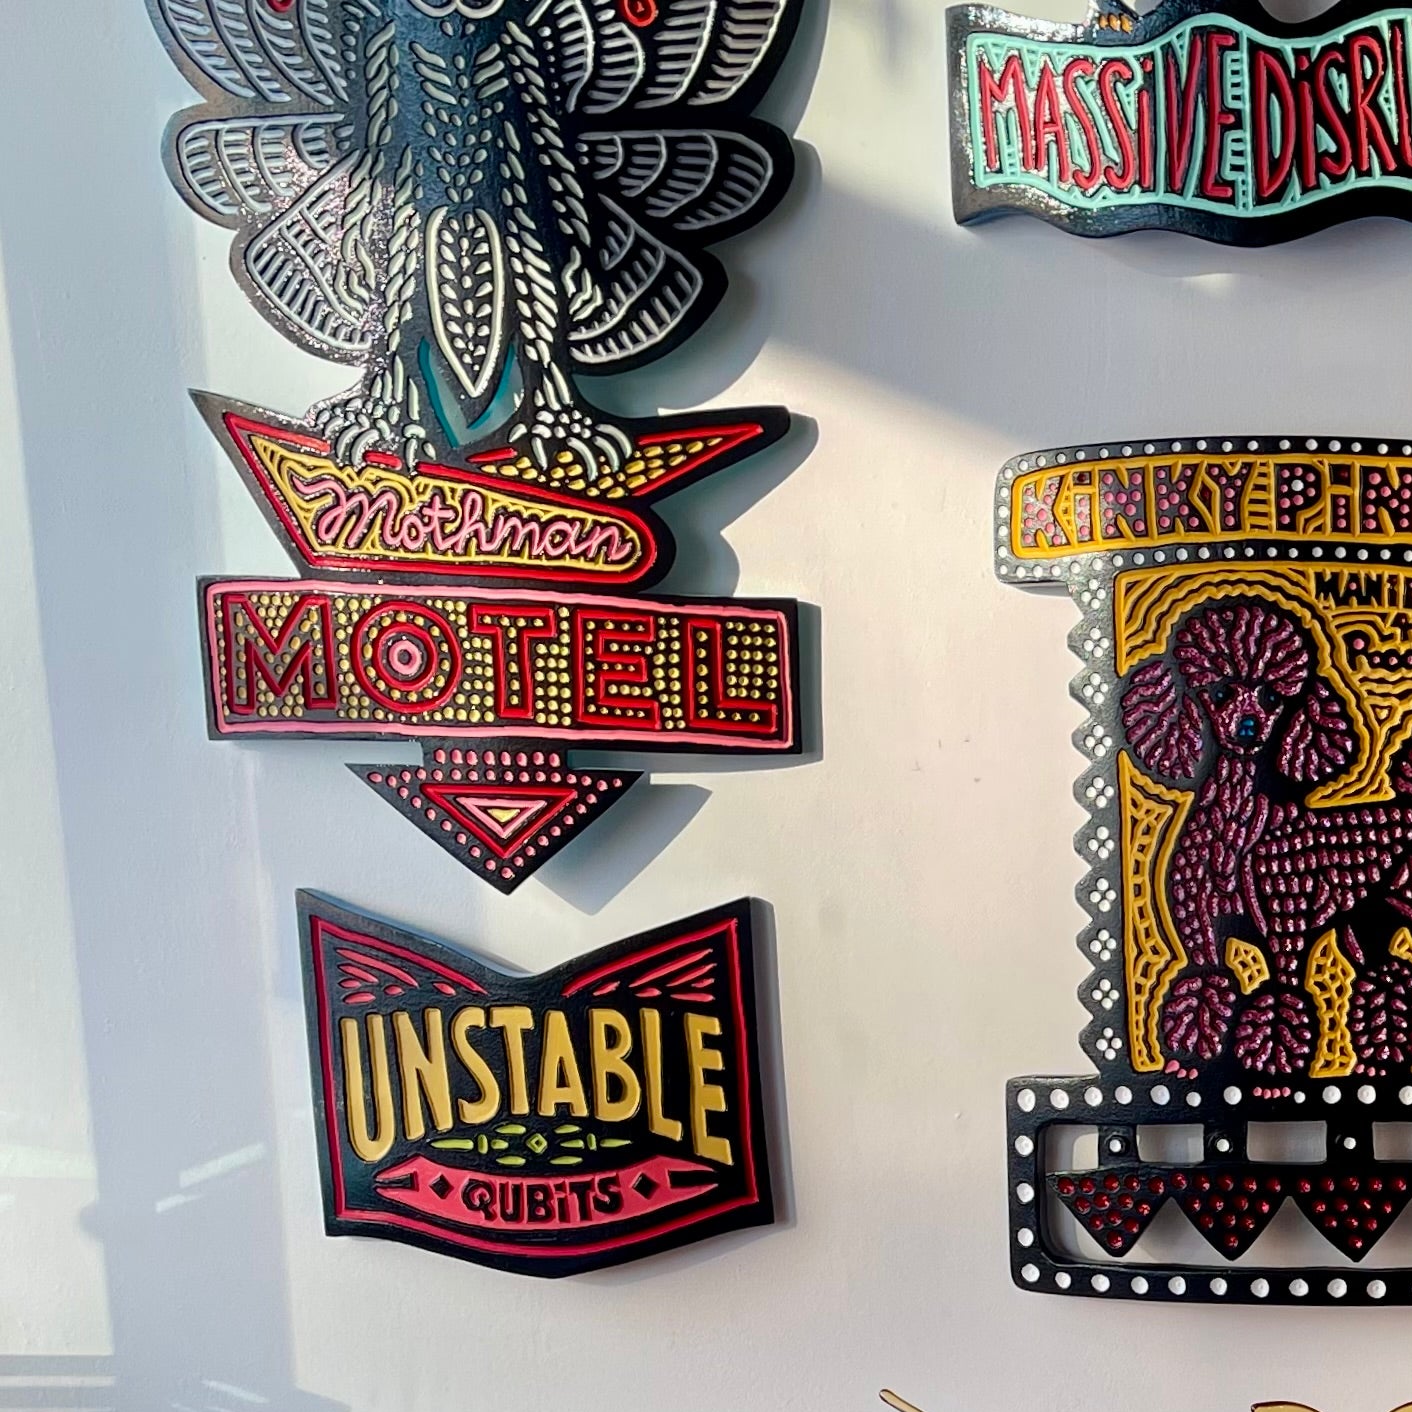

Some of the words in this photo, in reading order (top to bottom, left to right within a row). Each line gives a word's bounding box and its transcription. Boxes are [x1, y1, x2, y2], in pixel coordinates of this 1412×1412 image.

[291, 477, 633, 560] Mothman
[221, 594, 778, 734] MOTEL
[339, 1005, 734, 1165] UNSTABLE
